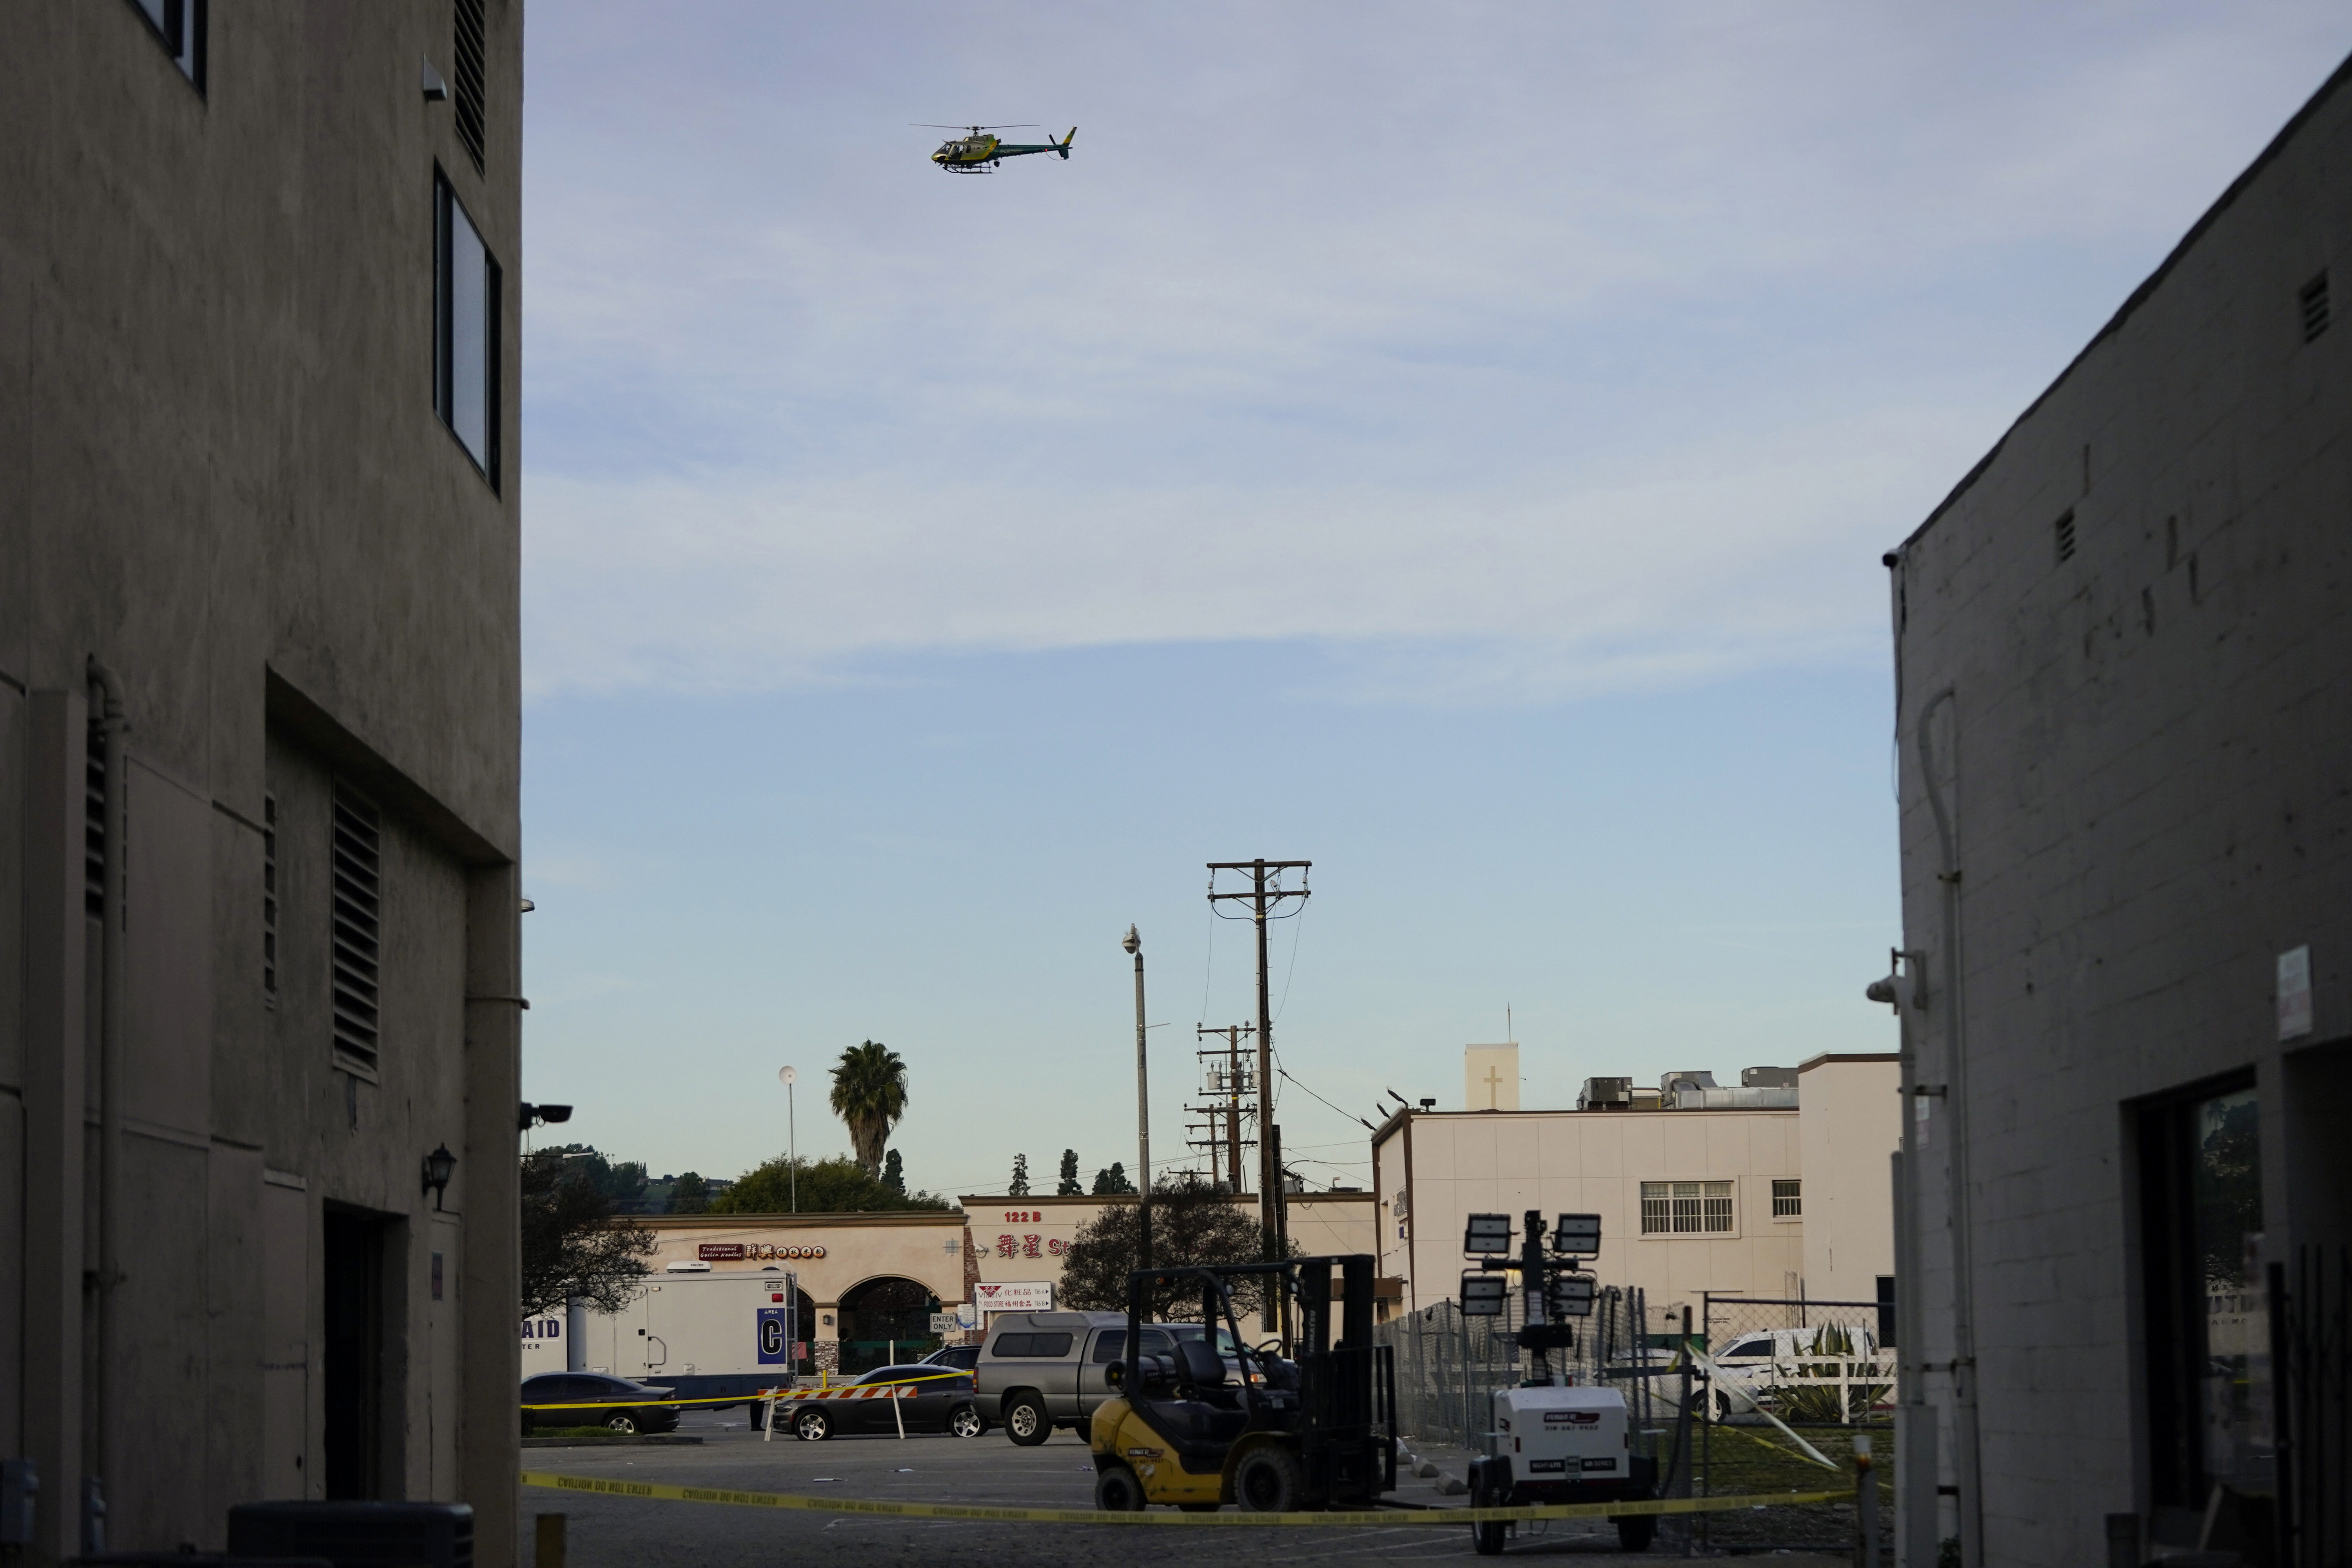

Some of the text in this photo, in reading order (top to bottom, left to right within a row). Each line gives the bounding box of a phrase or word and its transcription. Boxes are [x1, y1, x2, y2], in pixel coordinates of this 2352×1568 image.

[1005, 1211, 1041, 1222] 122 B
[995, 1234, 1042, 1258] 舞星
[522, 1320, 559, 1338] AID
[761, 1319, 782, 1354] C
